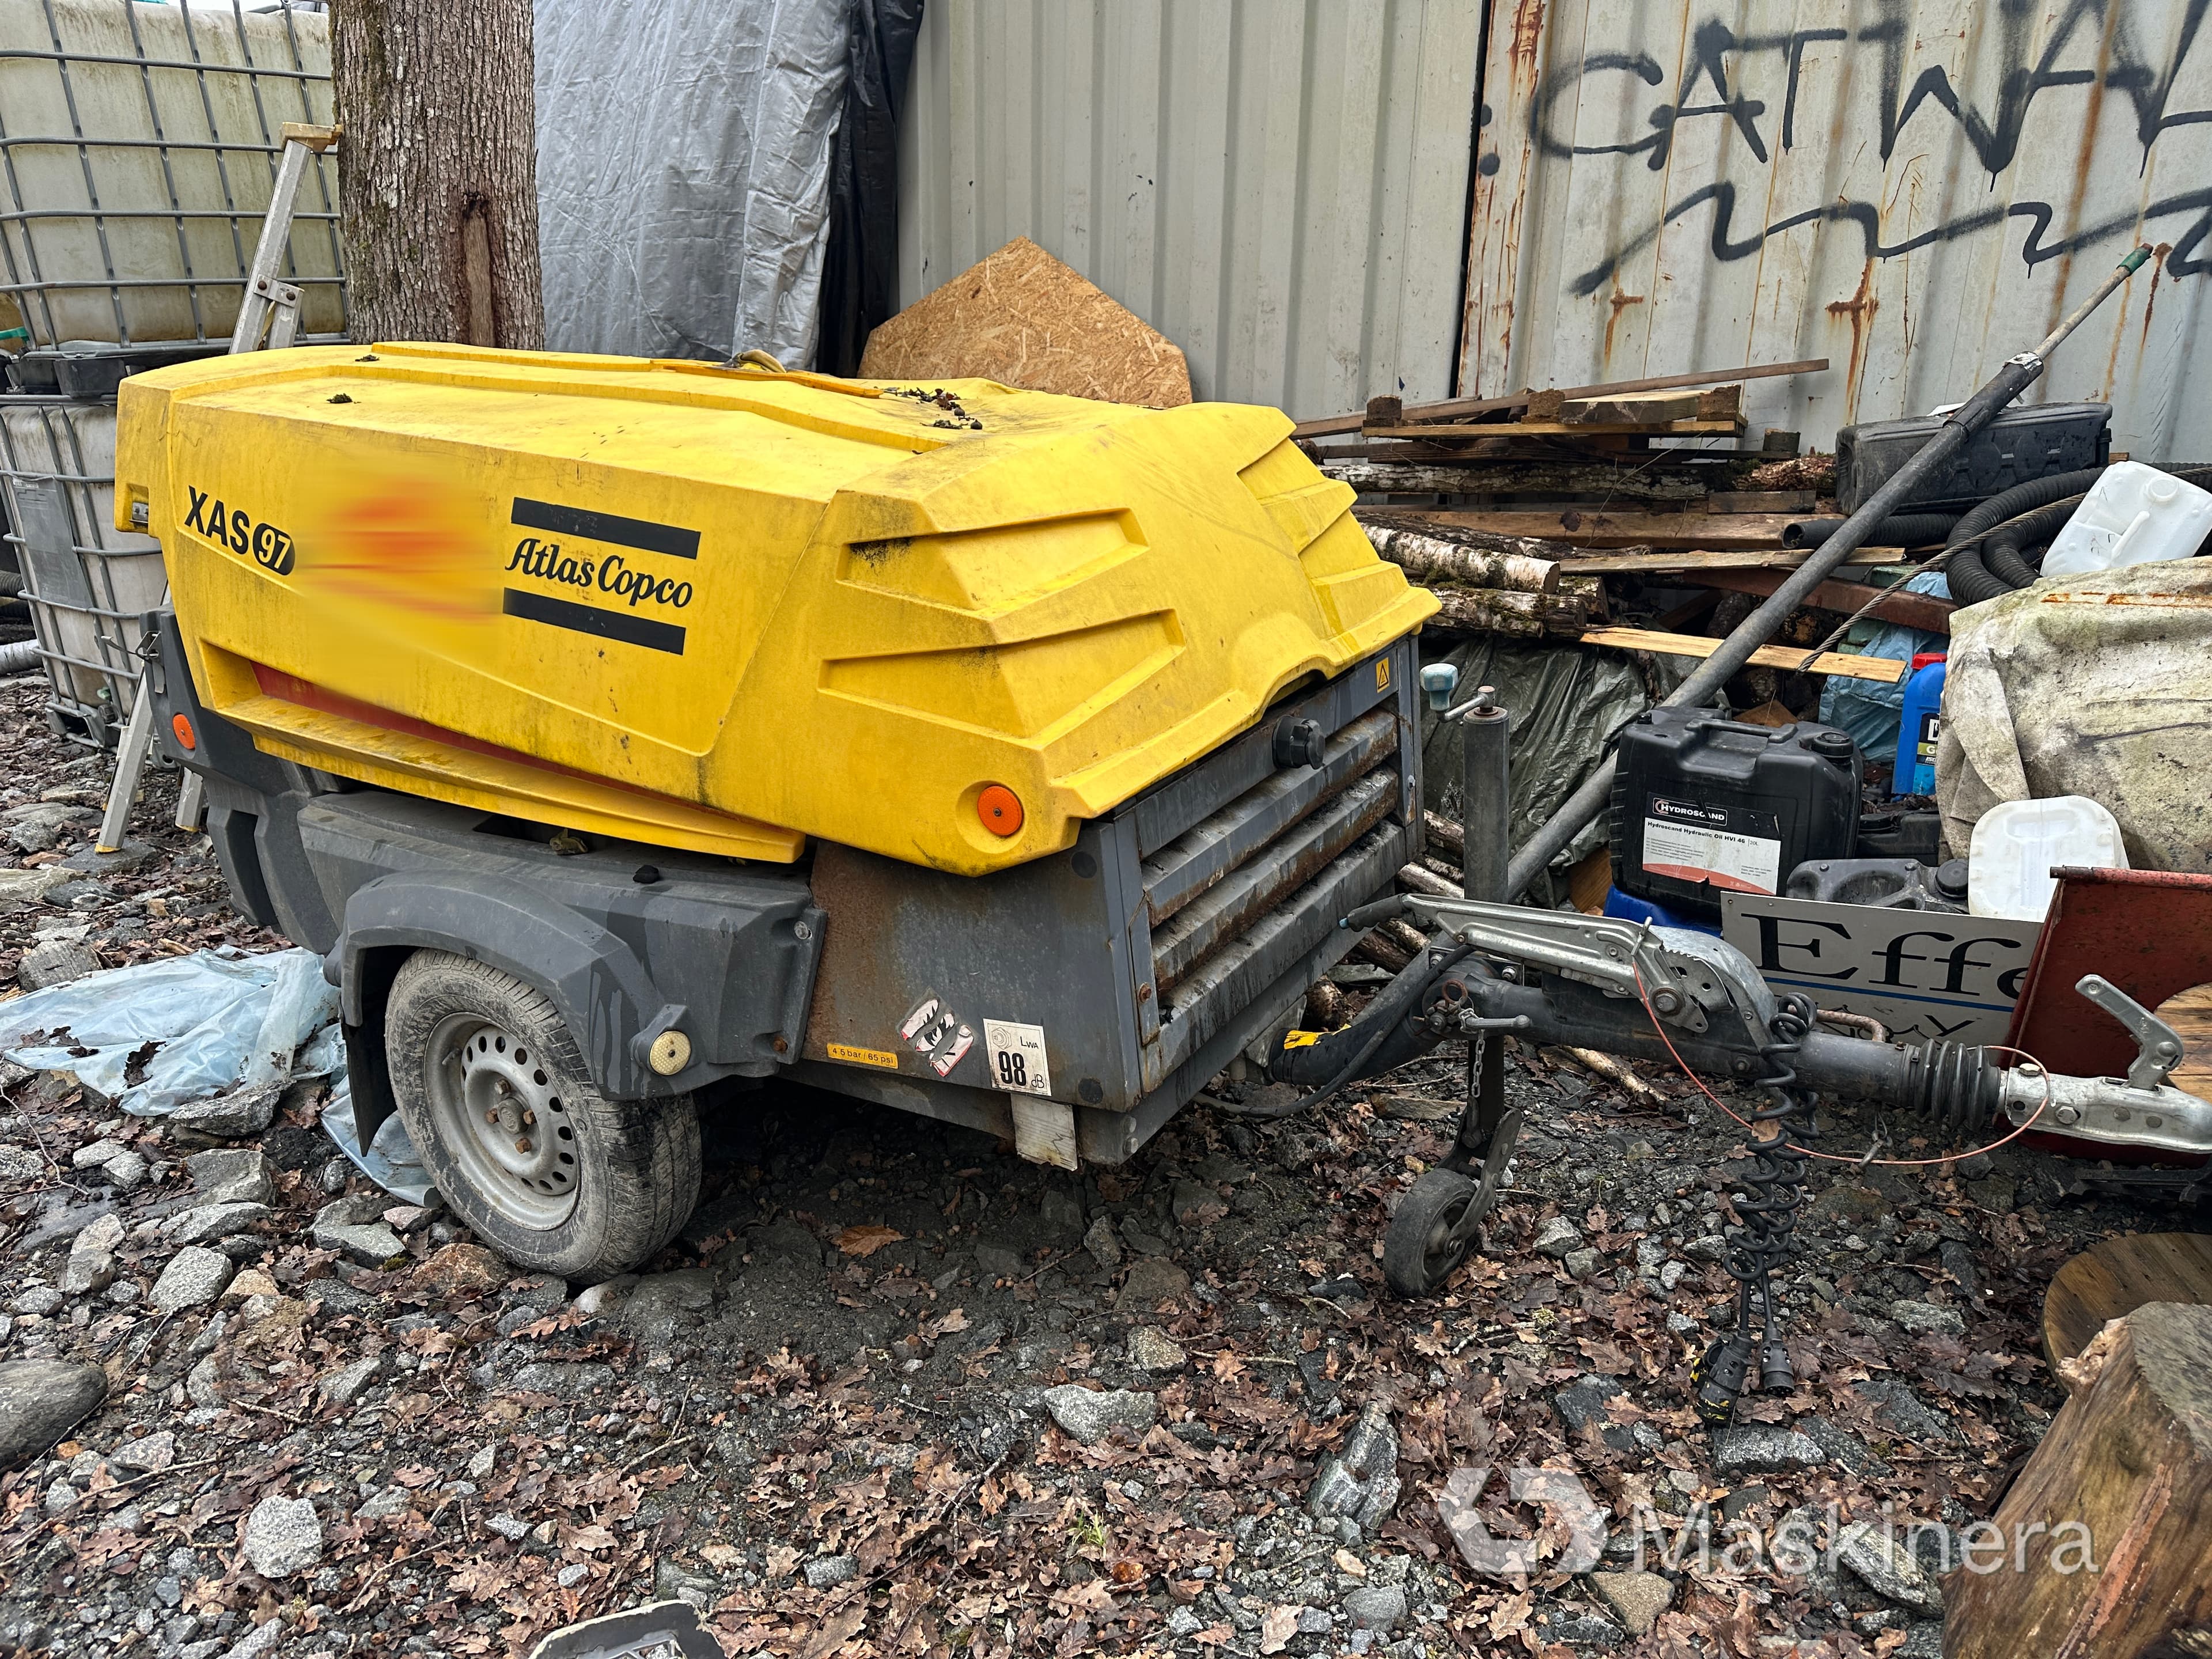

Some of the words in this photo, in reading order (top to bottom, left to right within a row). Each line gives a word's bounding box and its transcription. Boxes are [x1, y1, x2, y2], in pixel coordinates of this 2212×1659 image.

[184, 485, 249, 555] XAS
[257, 528, 291, 570] 97
[505, 538, 594, 587] Atlas
[598, 555, 692, 608] Copco
[1647, 821, 1682, 832] Hydroscand
[1684, 828, 1713, 838] Hydraulic
[1020, 1036, 1039, 1049] LWA
[832, 1048, 845, 1056] 4.5
[847, 1050, 861, 1058] bar
[880, 1056, 893, 1064] psi
[998, 1051, 1027, 1086] 98
[1031, 1074, 1044, 1088] dB
